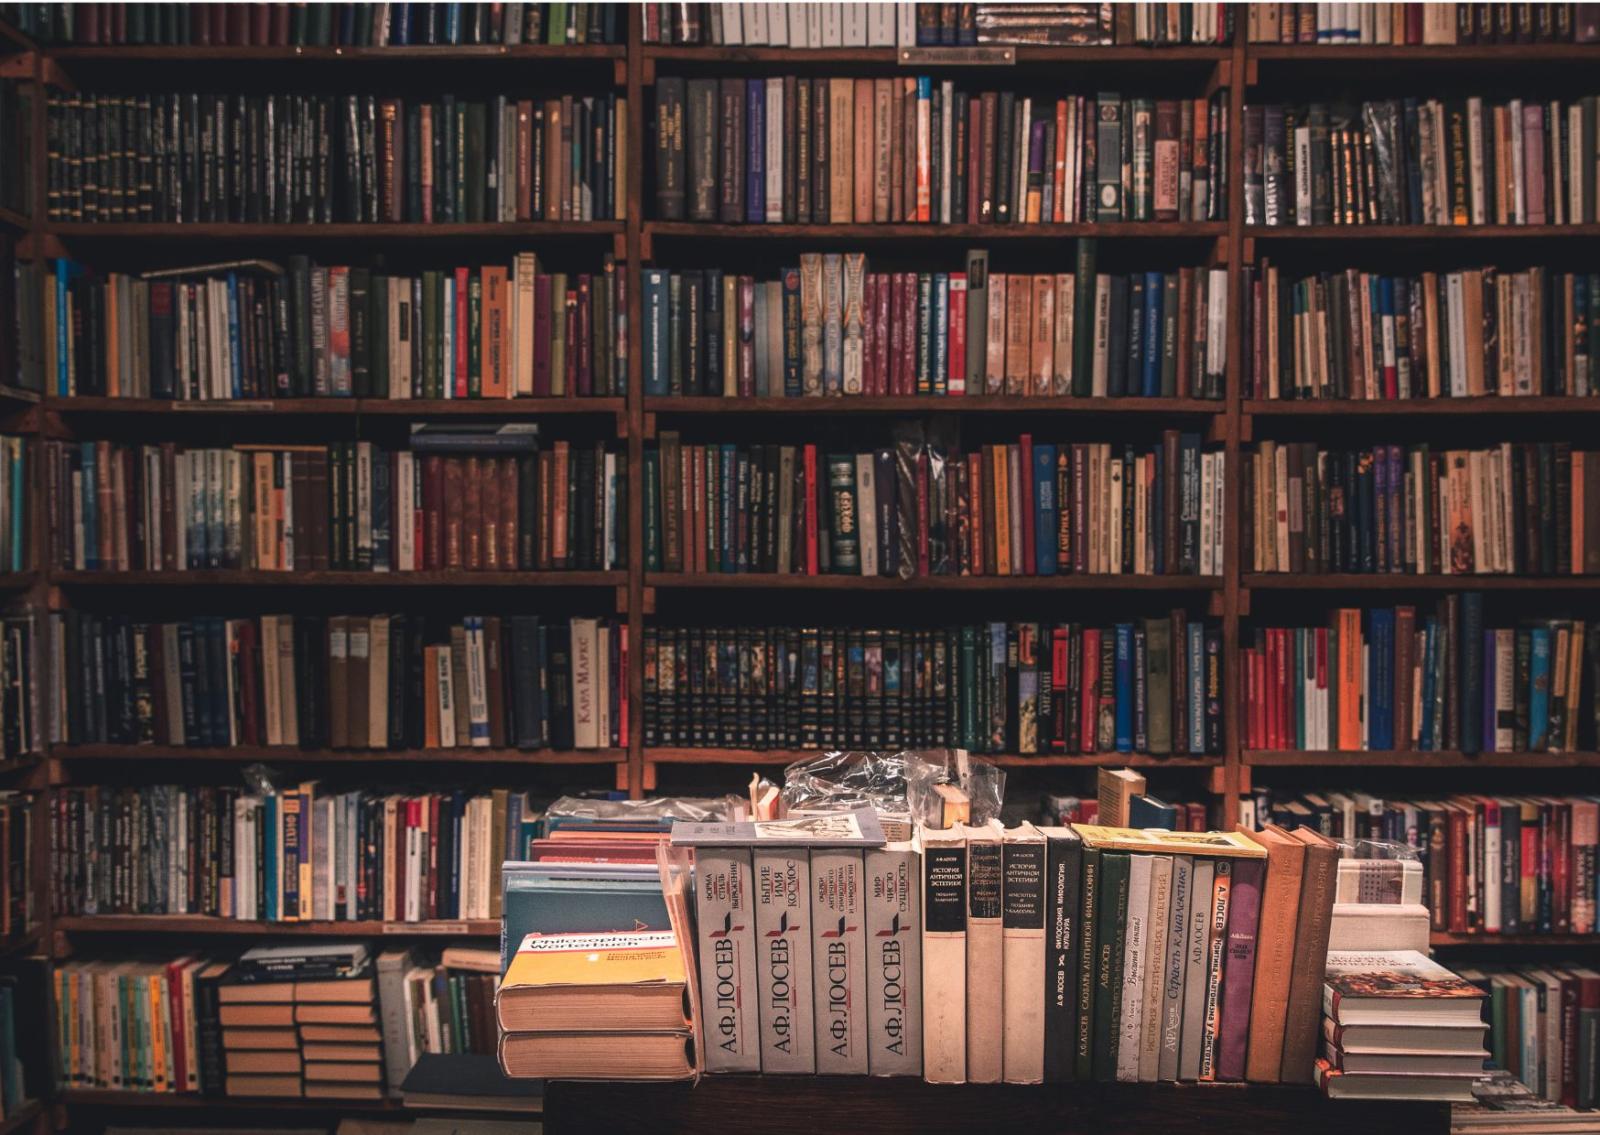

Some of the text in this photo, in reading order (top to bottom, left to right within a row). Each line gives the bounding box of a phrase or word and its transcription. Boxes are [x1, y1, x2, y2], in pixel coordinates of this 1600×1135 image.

[1060, 510, 1070, 551] АМЕРИКА
[576, 636, 590, 684] МАРКС
[704, 873, 714, 901] ФОРМА
[717, 873, 726, 900] СТИЛЬ
[729, 861, 739, 910] ВЫРАЖЕНИЕ
[760, 865, 772, 905] БЫТИЕ
[773, 871, 784, 898] ИМЯ
[786, 860, 798, 908] КОСМОС
[873, 876, 882, 898] МИФ
[885, 872, 895, 903] ЧИСЛО
[898, 861, 908, 913] СУЩНОСТЬ
[1085, 864, 1095, 918] ФИЛОСОФИИ
[1063, 917, 1072, 950] КУЛЬТУРА
[1215, 898, 1225, 929] ЛОСЕВ
[1083, 921, 1093, 970] АНТИЧНОЙ
[1212, 939, 1222, 972] Критика
[1081, 972, 1091, 1010] СЛОВАРЬ
[1167, 949, 1182, 1000] Страсть
[1207, 974, 1219, 1021] платонизма
[1145, 1006, 1158, 1053] ИСТОРИЯ
[1203, 1029, 1215, 1076] Аристотеля
